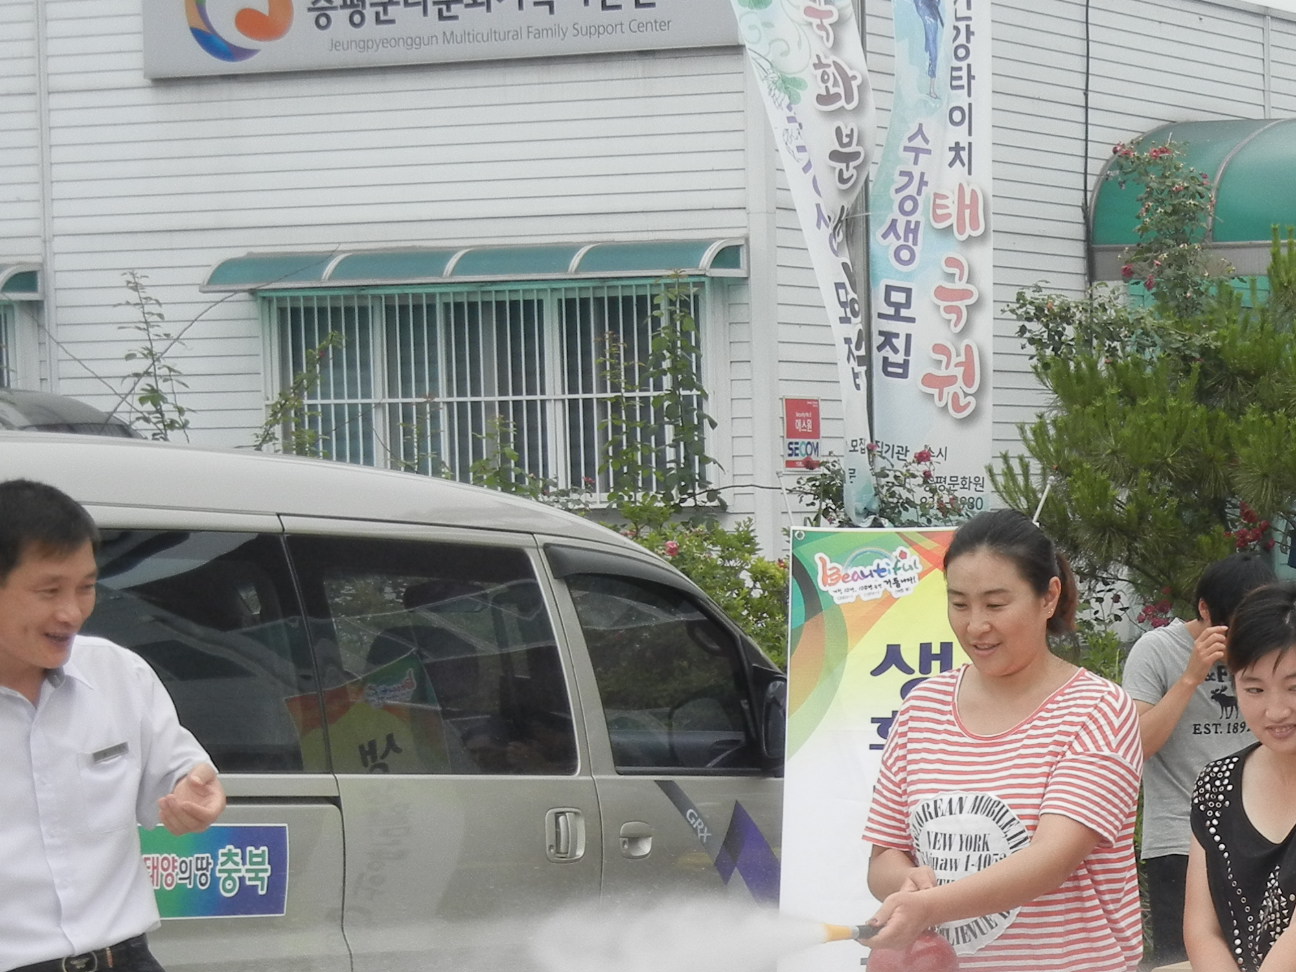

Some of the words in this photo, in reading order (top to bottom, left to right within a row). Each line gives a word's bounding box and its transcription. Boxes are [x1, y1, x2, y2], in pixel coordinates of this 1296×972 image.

[328, 34, 439, 53] Jeungpyeonggun
[442, 27, 523, 46] Multicultural
[527, 23, 569, 41] Family
[573, 21, 625, 38] Support
[628, 18, 673, 34] Center
[881, 122, 933, 267] 수강생
[876, 283, 917, 380] 모집
[787, 441, 820, 458] SECOM
[1193, 722, 1223, 735] EST.
[686, 808, 712, 843] GRX
[926, 830, 957, 852] NEW
[957, 833, 991, 853] YORK
[216, 845, 271, 897] 충북
